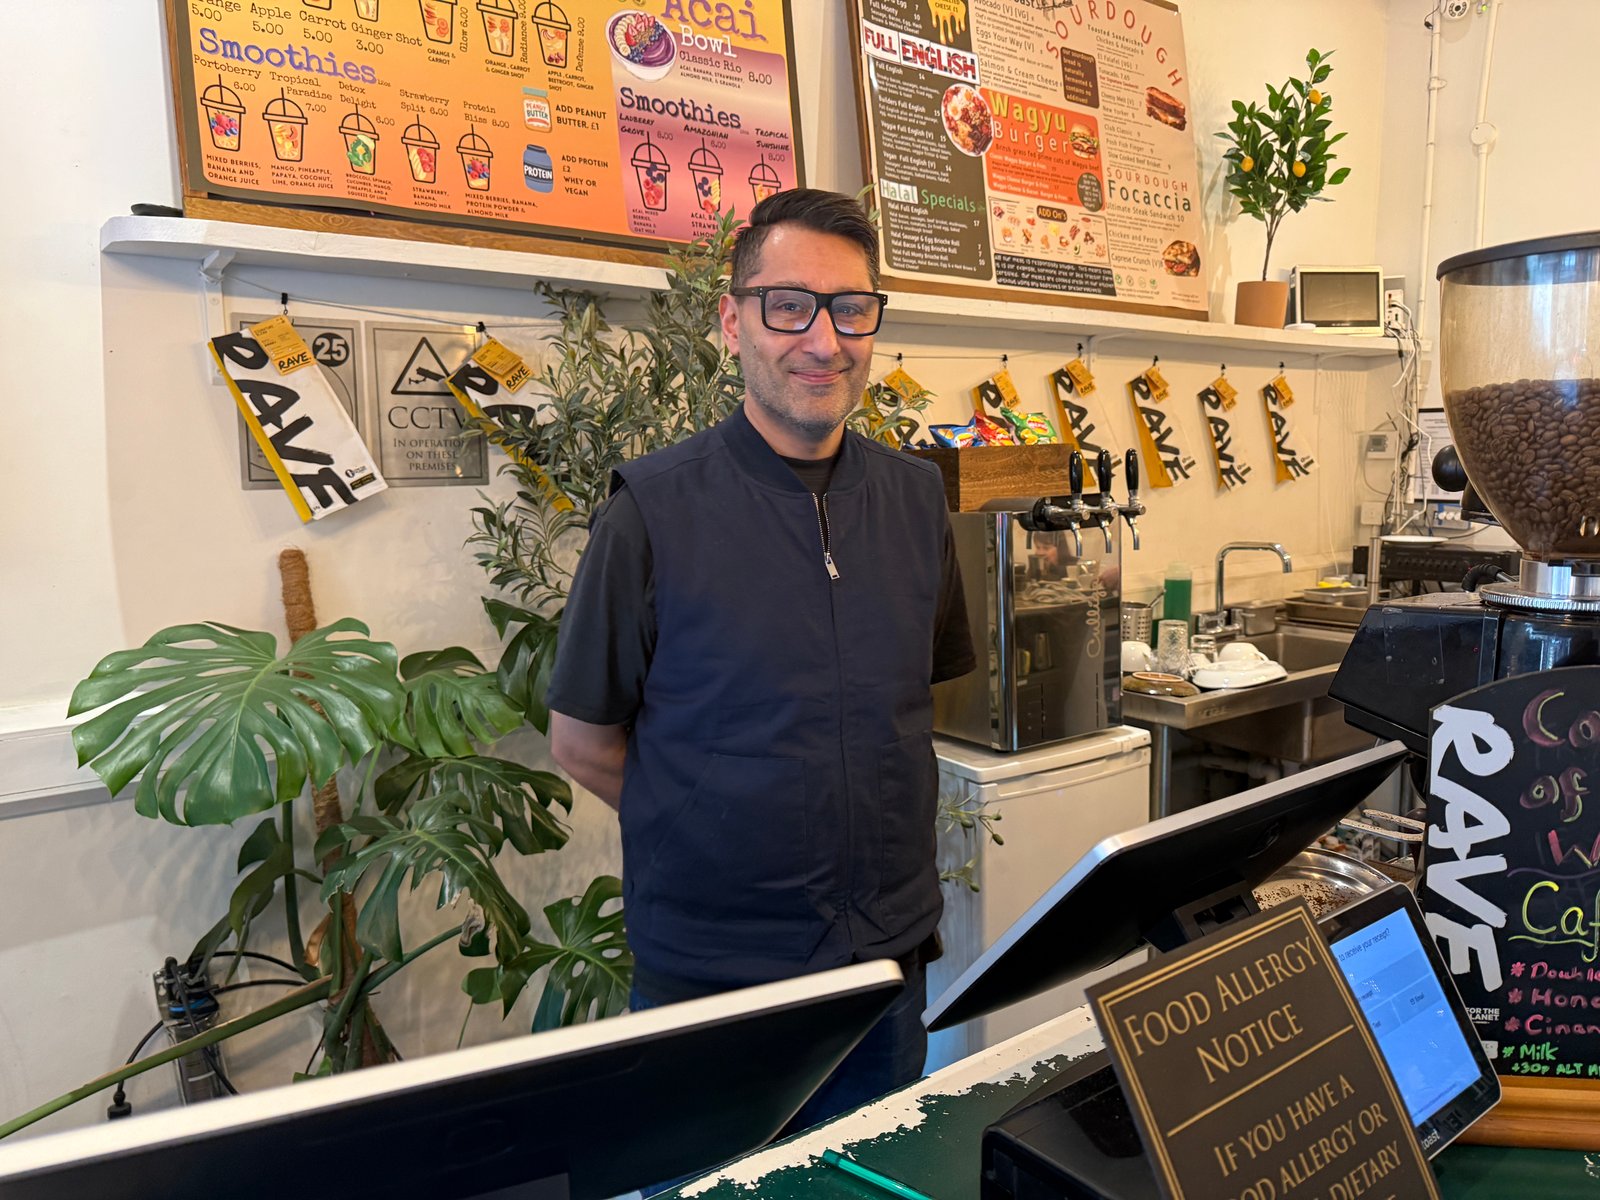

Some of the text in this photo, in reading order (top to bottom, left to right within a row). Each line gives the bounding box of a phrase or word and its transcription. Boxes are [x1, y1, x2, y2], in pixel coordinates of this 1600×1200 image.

[192, 3, 222, 21] 5.00
[250, 3, 291, 19] Apple
[881, 4, 898, 16] Monty
[934, 2, 951, 11] CHEESE
[299, 10, 347, 31] Carrot
[460, 7, 468, 28] 6.00
[252, 21, 284, 35] 5.00
[303, 28, 333, 43] 5.00
[351, 22, 422, 46] Ginger Shot
[520, 21, 528, 64] Radiance
[679, 24, 737, 58] Bowl
[976, 26, 1023, 49] Eggs Your Way
[1046, 0, 1183, 87] SOURDOUGH
[1088, 24, 1144, 48] Toasted Sandwiches
[1096, 35, 1114, 46] Chicken
[356, 39, 384, 54] 3.00
[427, 48, 450, 58] ORANGE
[864, 26, 897, 56] FULL
[901, 38, 976, 80] ENGLISH
[200, 27, 377, 84] Smoothies
[428, 56, 450, 65] CARROT
[680, 51, 742, 73] Classic Rio
[194, 54, 261, 79] Portoberry
[876, 61, 885, 69] Full
[886, 64, 903, 76] English
[980, 58, 1004, 71] Salmon
[1014, 68, 1035, 80] Cream
[1036, 74, 1058, 86] Cheese
[270, 72, 321, 87] Tropical
[748, 71, 773, 85] 8.00
[234, 81, 256, 92] 6.00
[287, 86, 332, 101] Paradise
[339, 81, 366, 94] Detox
[340, 94, 376, 109] Delight
[399, 89, 450, 106] Strawberry
[879, 95, 897, 106] Builders
[908, 103, 926, 113] English
[306, 103, 327, 113] 7.00
[401, 101, 425, 113] Split
[463, 101, 496, 114] Protein
[527, 109, 548, 120] BUTTER
[556, 104, 607, 119] ADD PEANUT
[620, 86, 741, 129] Smoothies
[988, 90, 1067, 135] Wagyu
[375, 115, 395, 127] 6.00
[464, 113, 488, 124] Bliss
[620, 125, 645, 136] GROVE
[684, 124, 729, 139] AMAZONIAN
[755, 128, 789, 139] TROPICAL
[897, 124, 925, 136] Full English
[993, 120, 1069, 154] Burger
[756, 140, 790, 151] SUNSHINE
[206, 154, 261, 169] MIXED BERRIES,
[561, 154, 609, 168] ADD PROTEIN
[883, 151, 927, 166] Vegan English
[207, 163, 237, 174] BANANA
[524, 165, 553, 180] PROTEIN
[208, 171, 260, 185] ORANGE JUICE
[563, 176, 597, 187] WHEY OR
[1107, 167, 1188, 192] SOURDOUGH
[564, 187, 589, 196] VEGAN
[881, 182, 976, 213] Halal Specials
[1108, 179, 1192, 212] Focaccia
[467, 209, 493, 217] ALMOND
[911, 206, 929, 215] English
[1039, 209, 1052, 217] ADD
[1132, 206, 1148, 216] Steak
[1150, 211, 1175, 220] Sandwich
[902, 233, 919, 242] Sausage
[315, 337, 347, 361] 25
[506, 366, 528, 388] RAVE
[394, 438, 464, 447] IN OPERATIO
[406, 451, 423, 459] ON
[1520, 767, 1590, 823] of
[1426, 704, 1514, 992] RAVE
[1338, 928, 1390, 962] to receive your receipt?
[1124, 936, 1319, 1057] FOOD ALLERGY
[1196, 1003, 1304, 1084] NOTICE
[1520, 1041, 1559, 1060] Milk
[1511, 1061, 1583, 1075] +30p ALT
[1214, 1074, 1355, 1177] IF YOU HAVE A
[1421, 1128, 1440, 1150] toast
[1280, 1101, 1389, 1194] ALLERGY OR
[1329, 1141, 1403, 1200] DIETARY
